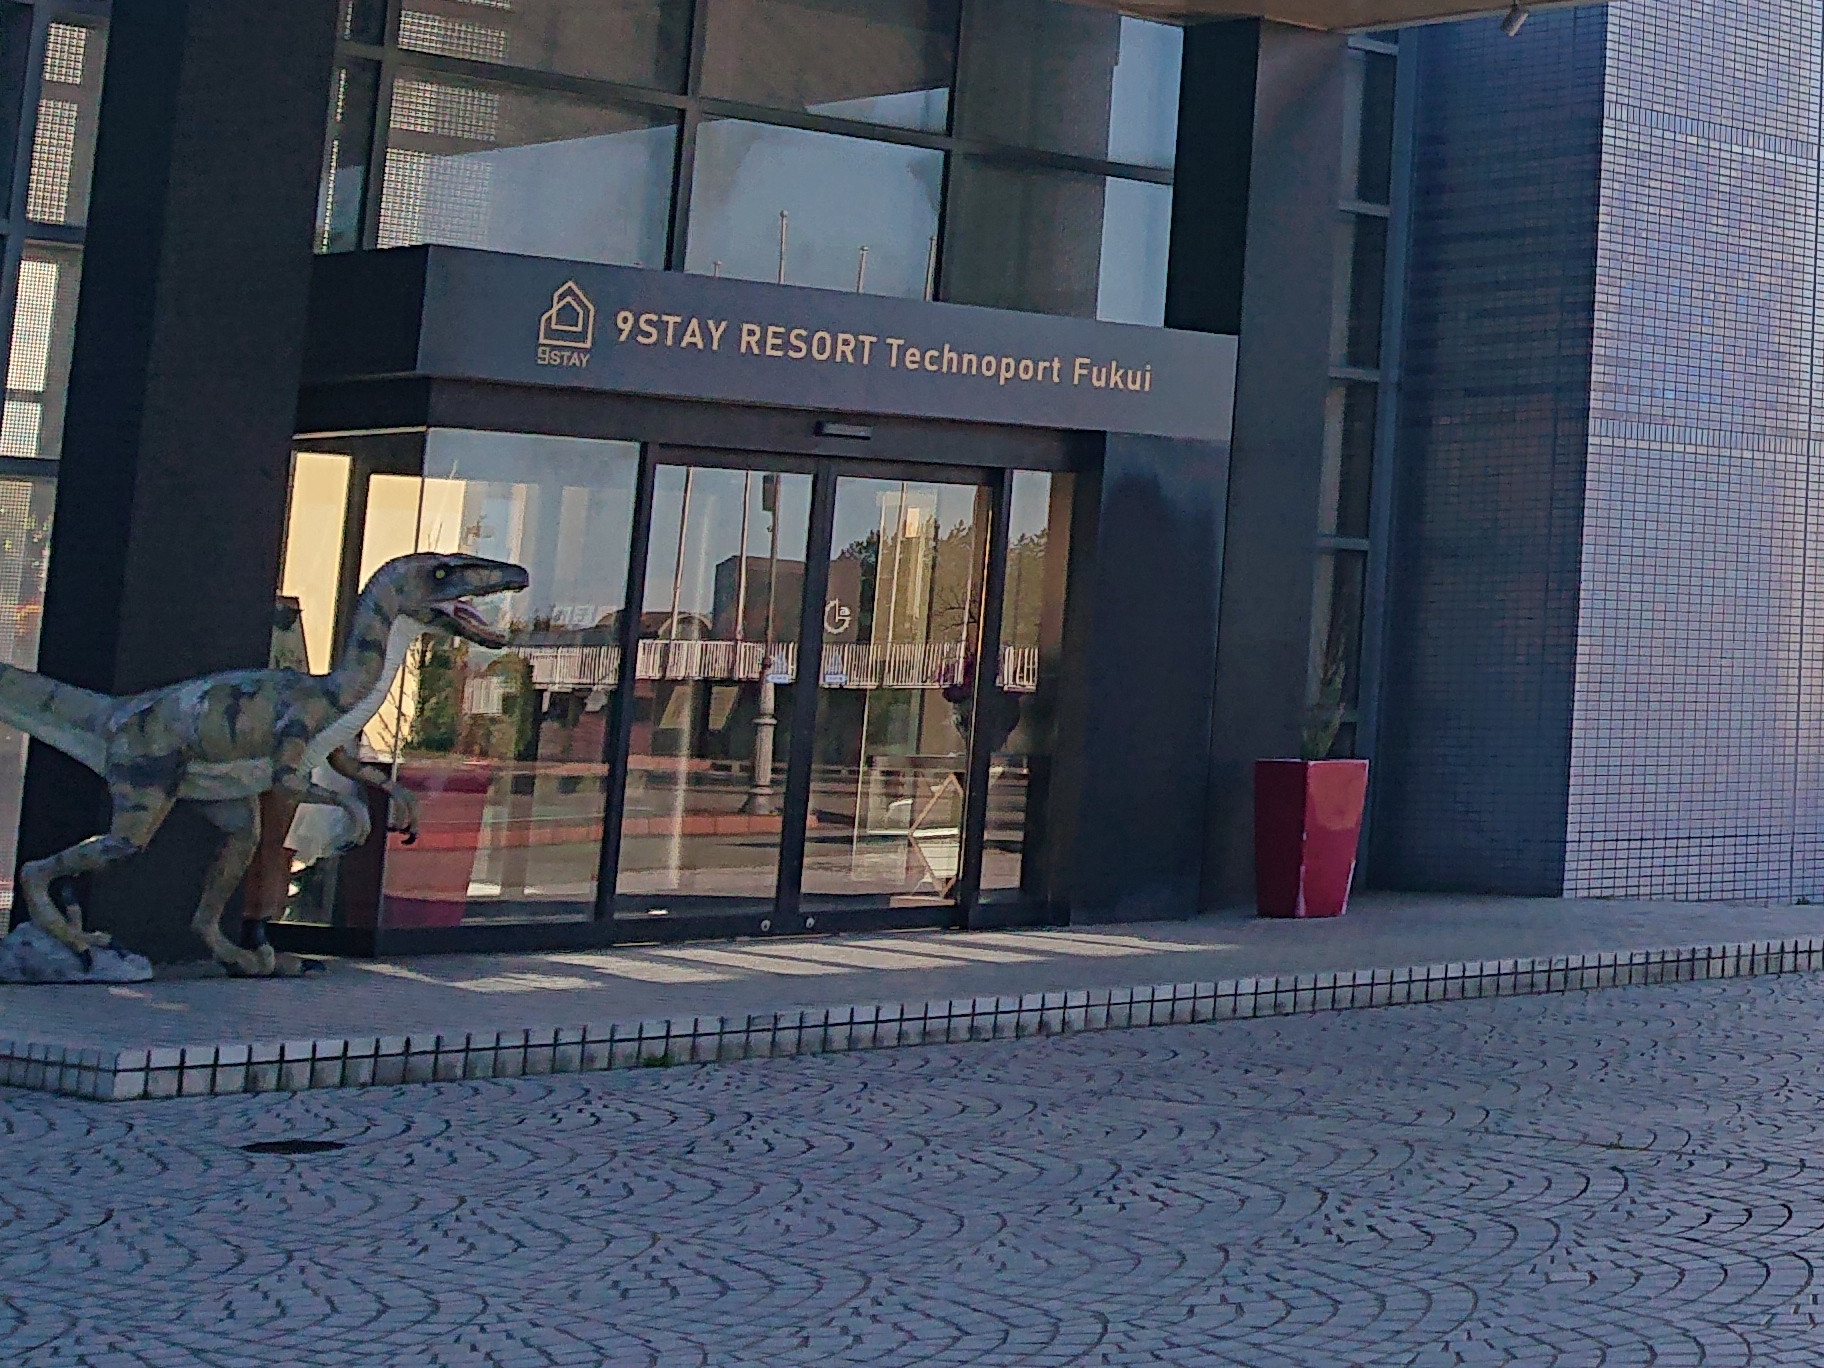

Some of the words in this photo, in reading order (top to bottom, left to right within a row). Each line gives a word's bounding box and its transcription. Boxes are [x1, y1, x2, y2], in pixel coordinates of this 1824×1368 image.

[536, 345, 590, 368] 9STAY
[616, 310, 728, 351] 9STAY
[739, 322, 878, 366] RESORT
[885, 337, 1061, 386] Technoport
[1073, 357, 1152, 392] Fukui
